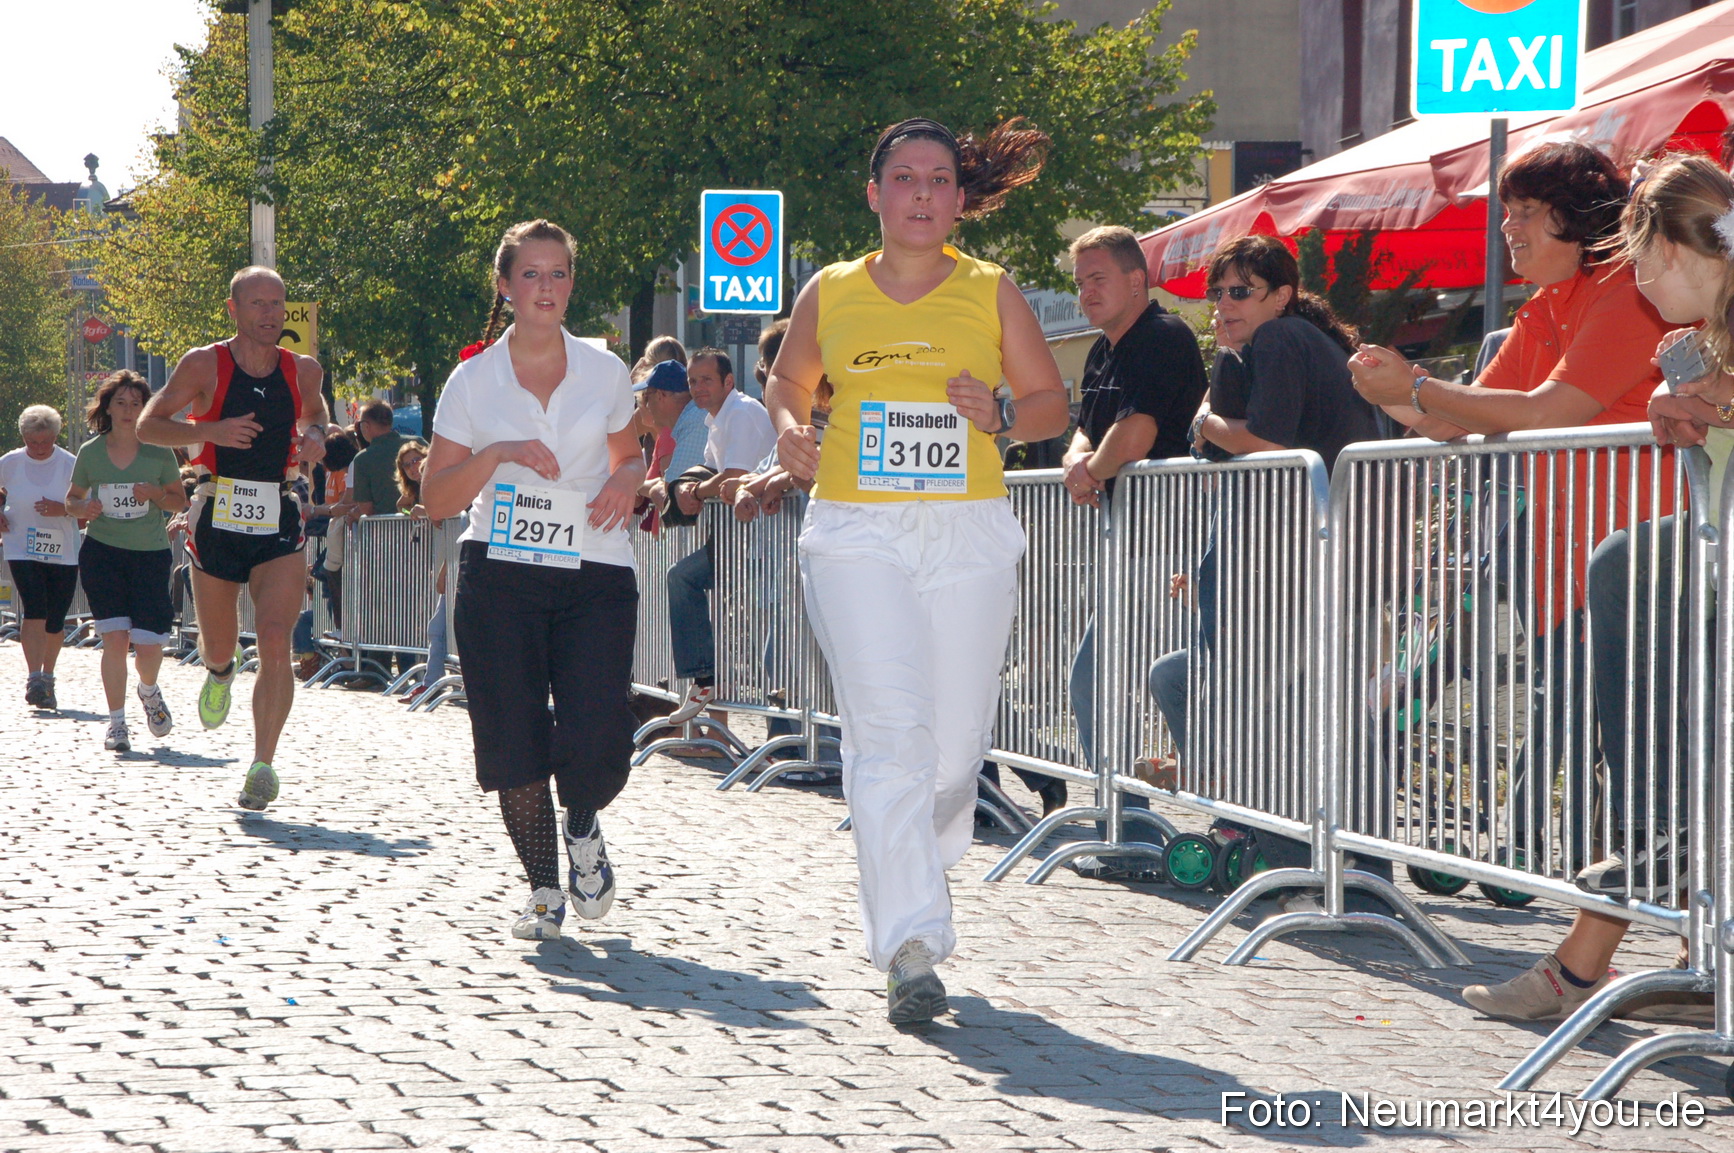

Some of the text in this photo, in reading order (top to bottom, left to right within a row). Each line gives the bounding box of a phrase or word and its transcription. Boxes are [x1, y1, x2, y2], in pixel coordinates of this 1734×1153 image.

[1430, 34, 1563, 93] TAXI
[709, 275, 773, 302] TAXI
[284, 306, 309, 323] ock
[852, 346, 946, 367] Gym 2000
[888, 411, 958, 429] Elisabeth
[866, 434, 878, 448] D
[888, 440, 961, 468] 3102
[233, 485, 258, 497] Ernst
[926, 479, 966, 488] PFLEIDERER
[218, 497, 226, 506] A
[515, 493, 552, 510] Anica
[232, 502, 265, 520] 333
[497, 511, 507, 524] D
[36, 531, 52, 540] Berta
[513, 518, 574, 546] 2971
[35, 541, 61, 554] 2787
[543, 553, 580, 564] PFLEIDERER
